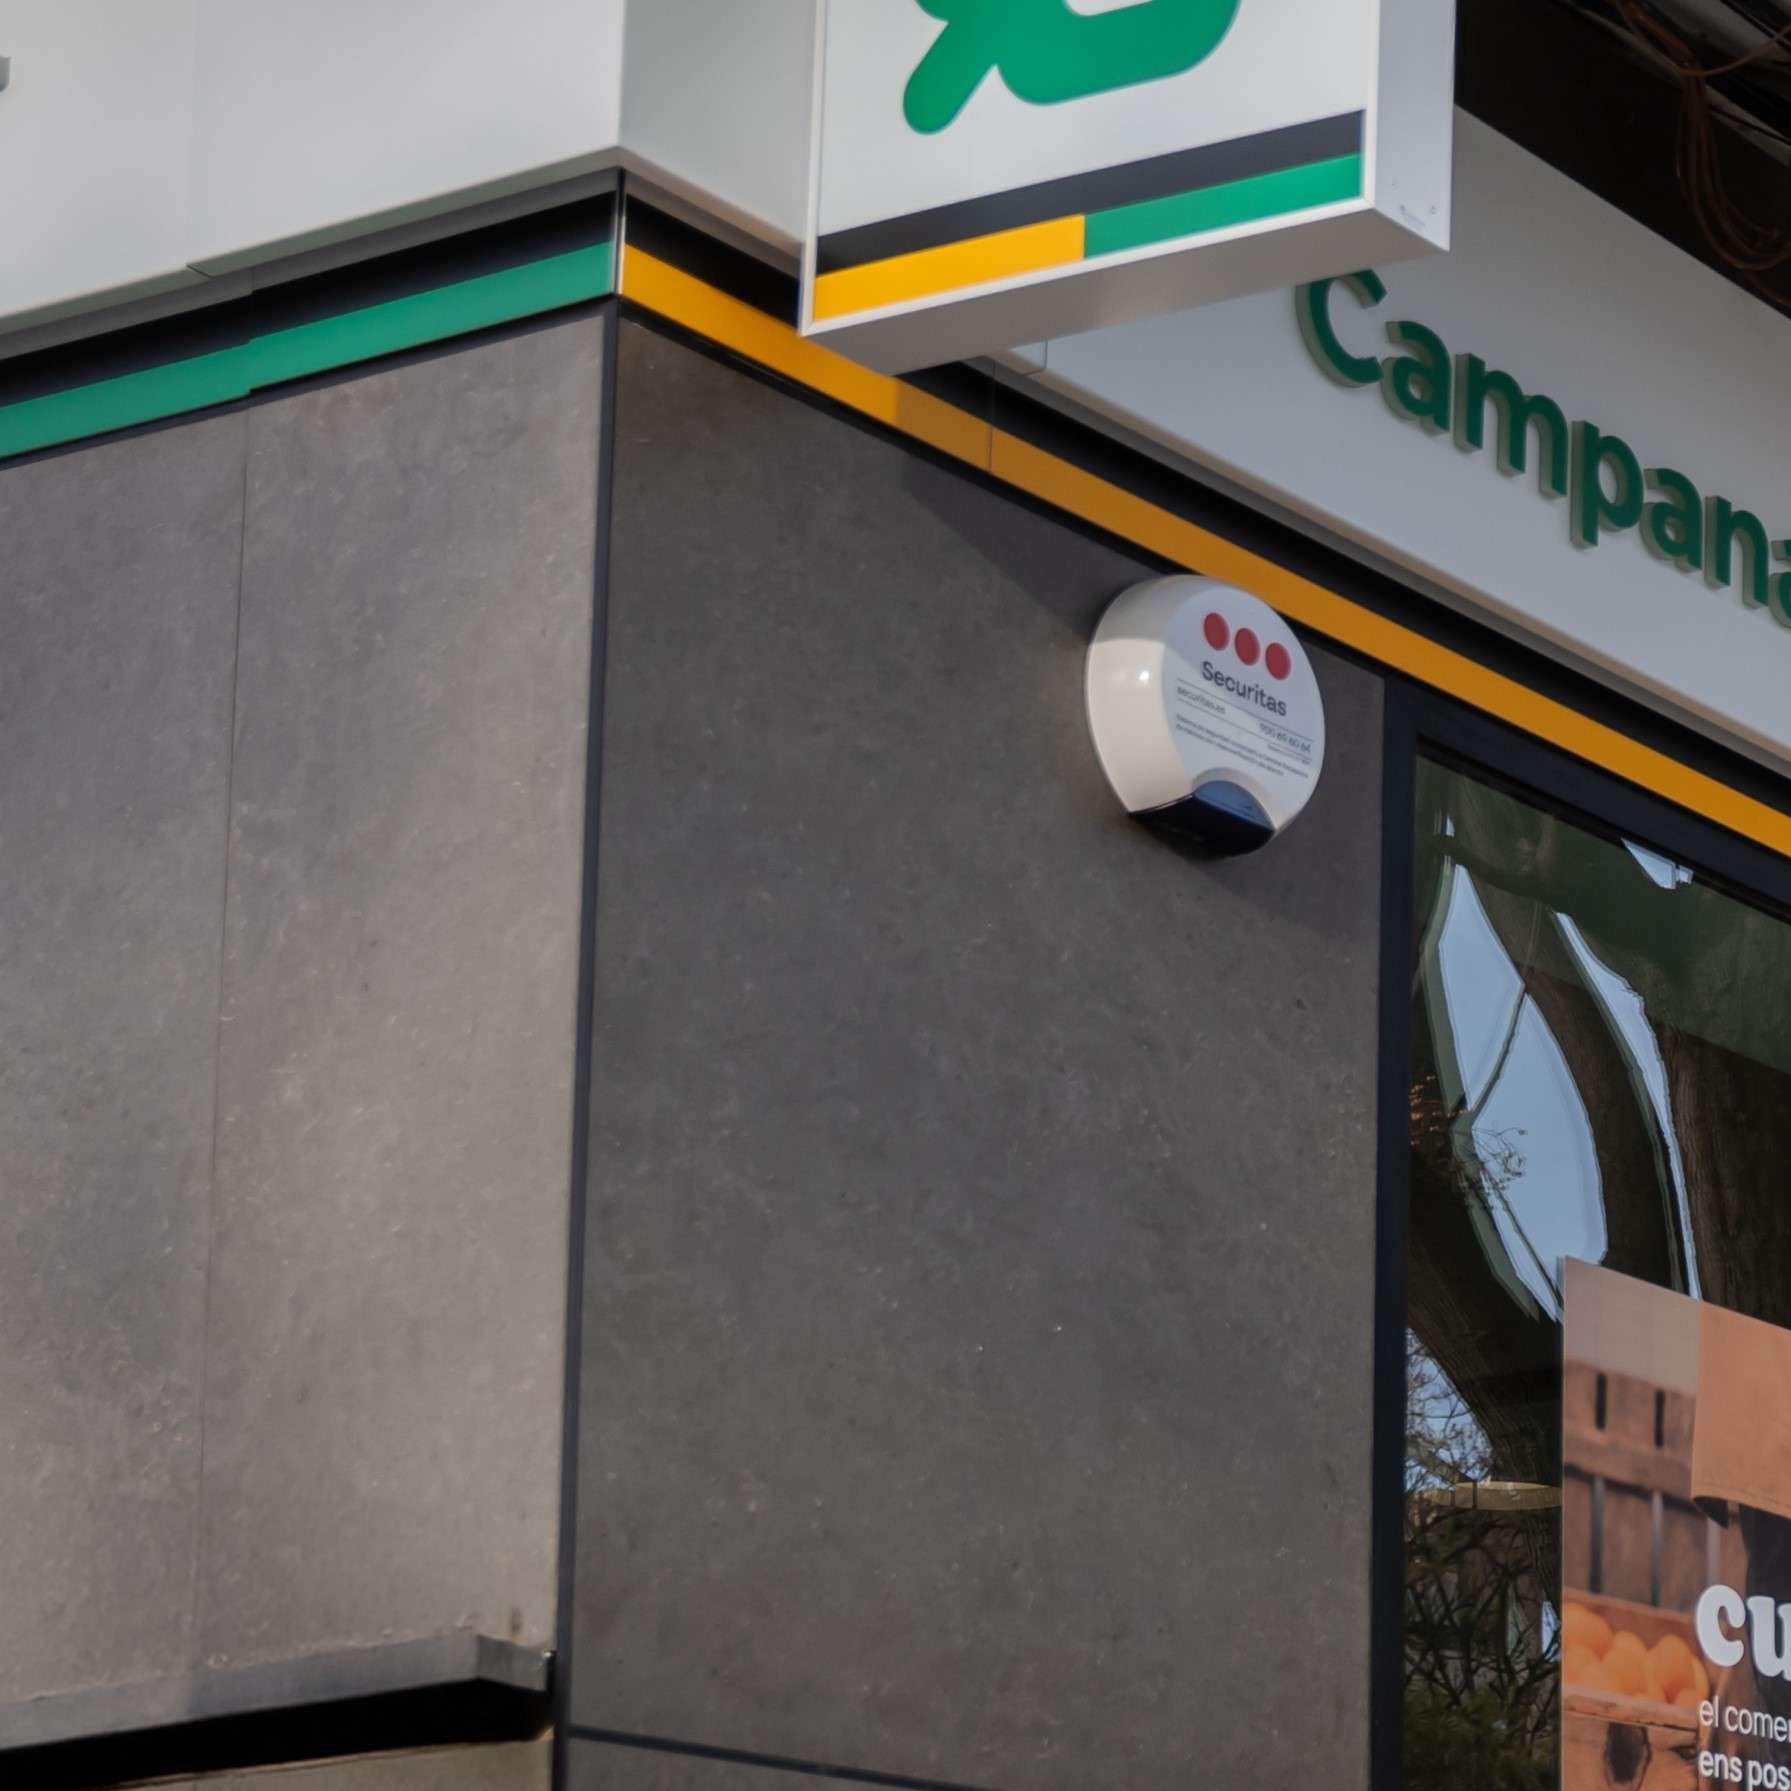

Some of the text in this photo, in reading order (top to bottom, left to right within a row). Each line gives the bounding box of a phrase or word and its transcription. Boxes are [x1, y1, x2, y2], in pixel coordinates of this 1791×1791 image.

[1202, 660, 1287, 717] Securitas
[1698, 1697, 1720, 1728] el
[1698, 1751, 1742, 1782] ens
